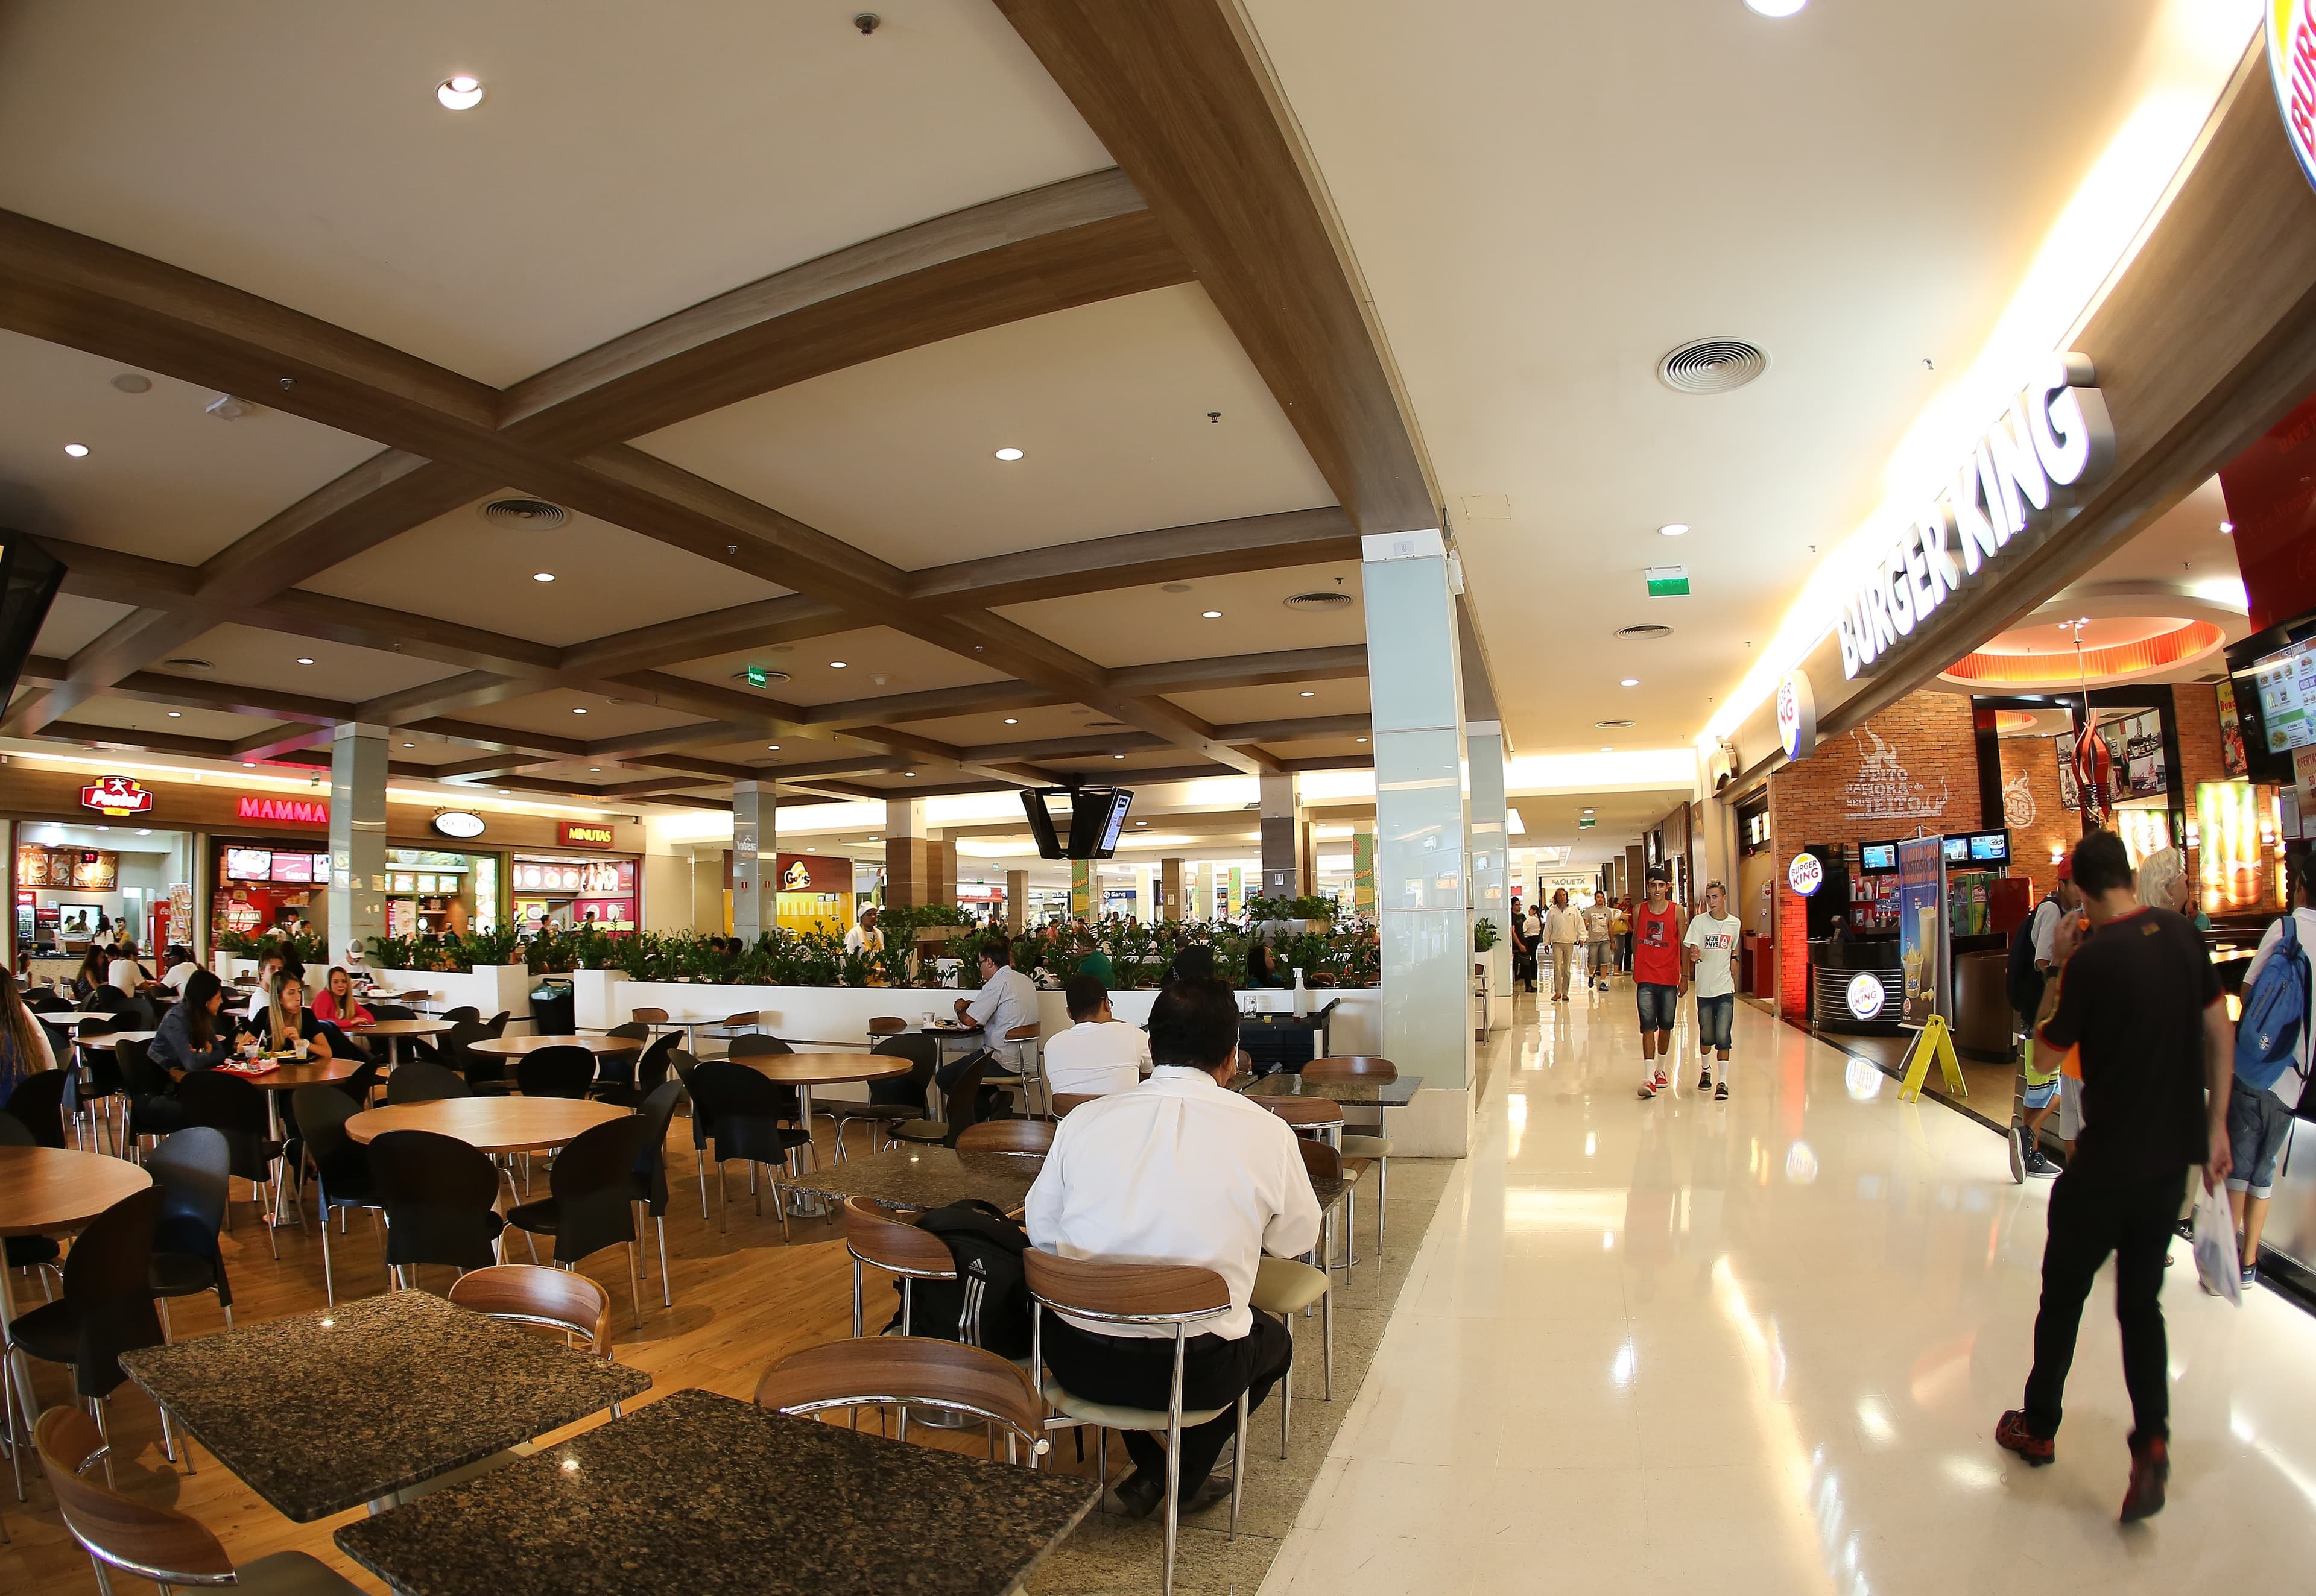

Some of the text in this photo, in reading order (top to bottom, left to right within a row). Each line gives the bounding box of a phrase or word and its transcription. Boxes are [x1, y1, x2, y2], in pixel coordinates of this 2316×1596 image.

[1837, 355, 2090, 680] BURGER KING
[1859, 768, 1908, 782] FEITO
[1861, 783, 1909, 796] HORA
[90, 790, 145, 808] Pastel
[239, 796, 327, 822] MAMMA
[569, 828, 612, 842] MINUTAS
[1791, 860, 1817, 877] BURGER
[1794, 868, 1818, 888] KING
[1855, 991, 1876, 1006] KING
[968, 1265, 987, 1275] adidas
